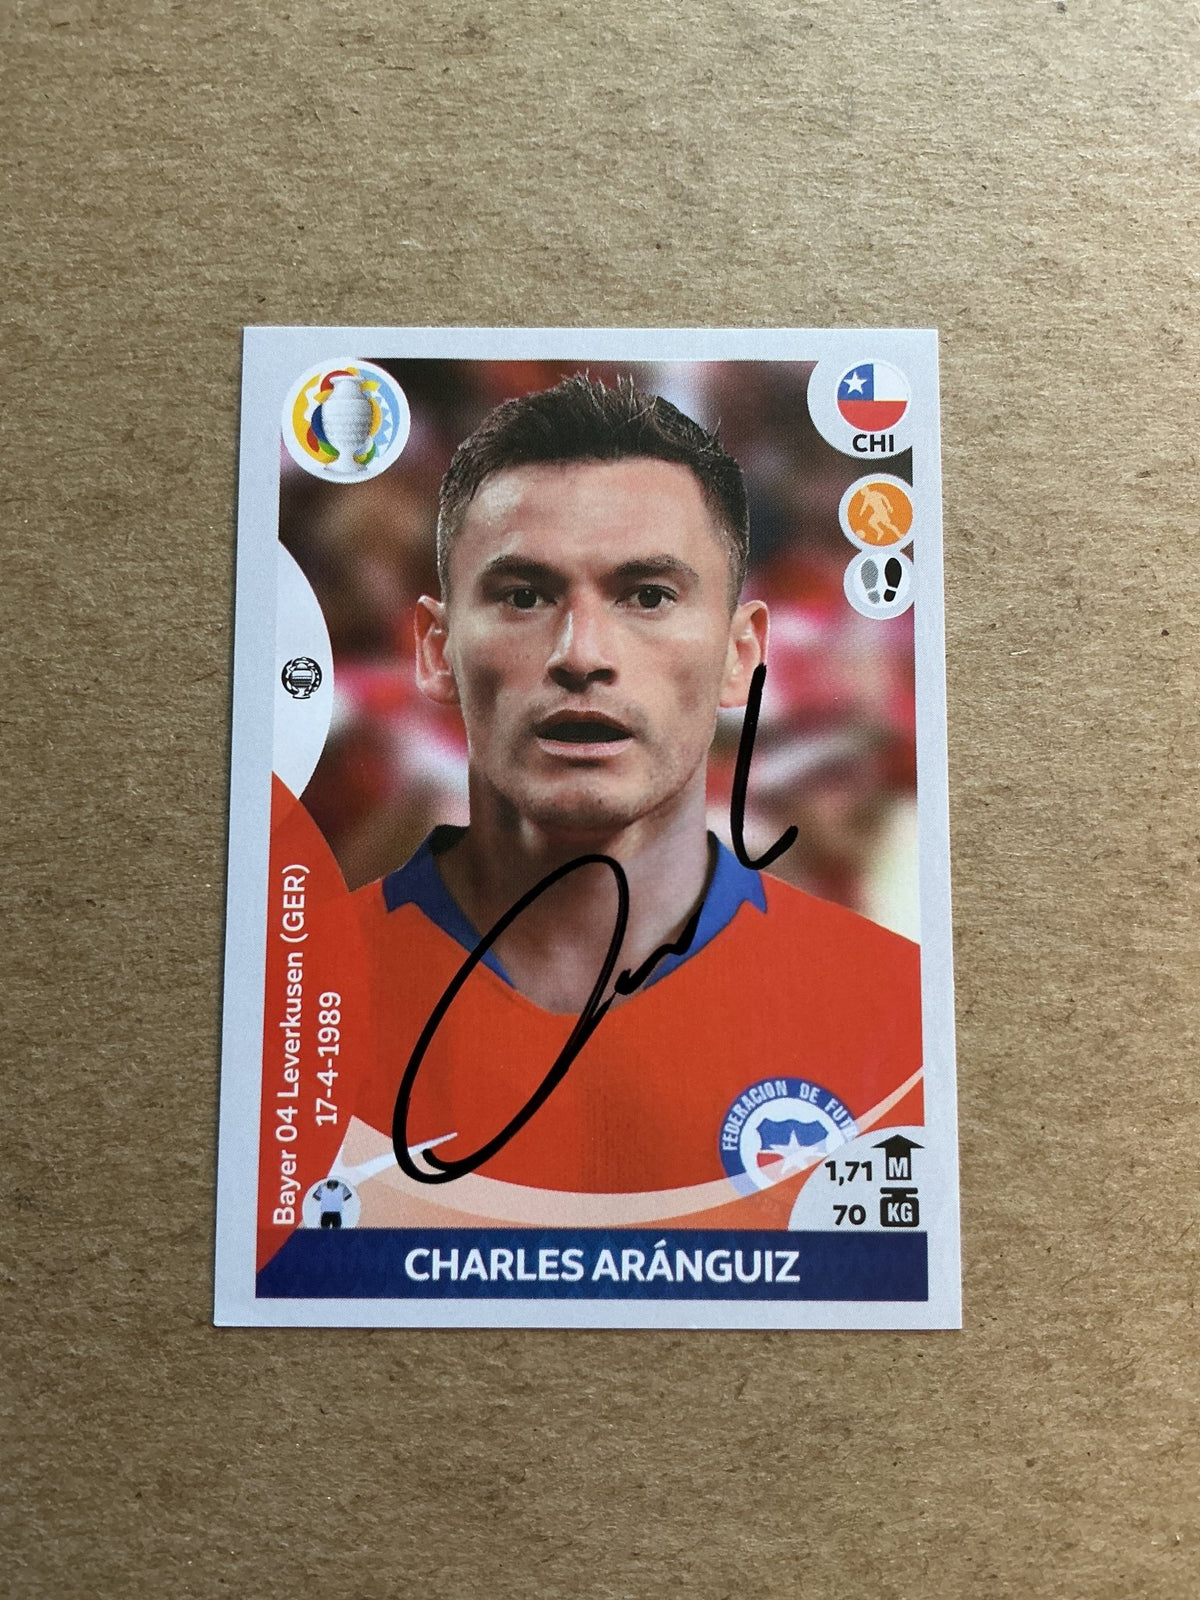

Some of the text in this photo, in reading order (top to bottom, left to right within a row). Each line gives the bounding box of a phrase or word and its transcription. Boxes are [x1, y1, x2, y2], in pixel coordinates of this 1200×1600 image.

[852, 434, 894, 453] CHI
[272, 864, 310, 1225] Bayer 04 Leverkusen (GER)
[314, 991, 342, 1126] 17-4-1989
[722, 1080, 788, 1151] FEDERACION
[799, 1082, 820, 1104] DE
[825, 1156, 909, 1186] 1,71 M
[832, 1202, 914, 1226] 70 KG
[404, 1239, 801, 1283] CHARLES ARÁNGUIZ
